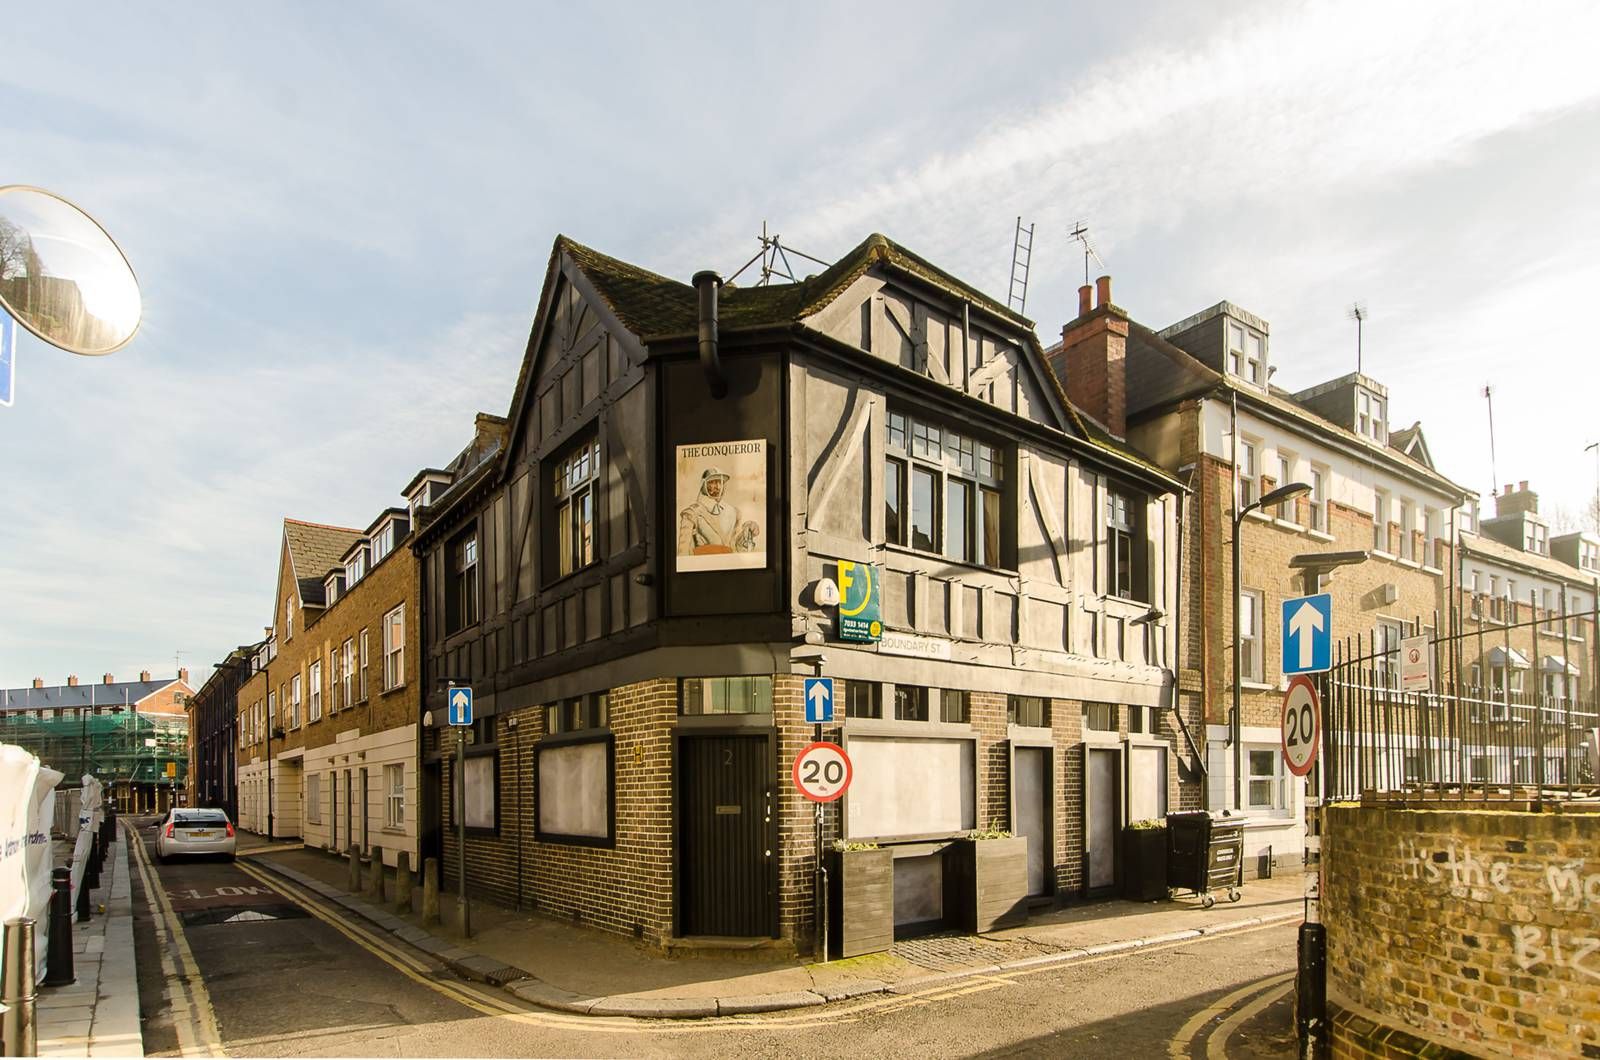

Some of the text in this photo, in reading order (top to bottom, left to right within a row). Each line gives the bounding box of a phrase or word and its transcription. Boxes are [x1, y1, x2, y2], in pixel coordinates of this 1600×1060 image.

[682, 443, 761, 458] THE CONQUEROR
[881, 638, 940, 653] BOUNDARY ST
[1287, 703, 1313, 747] 20
[802, 759, 843, 784] 20
[1444, 843, 1513, 893] the
